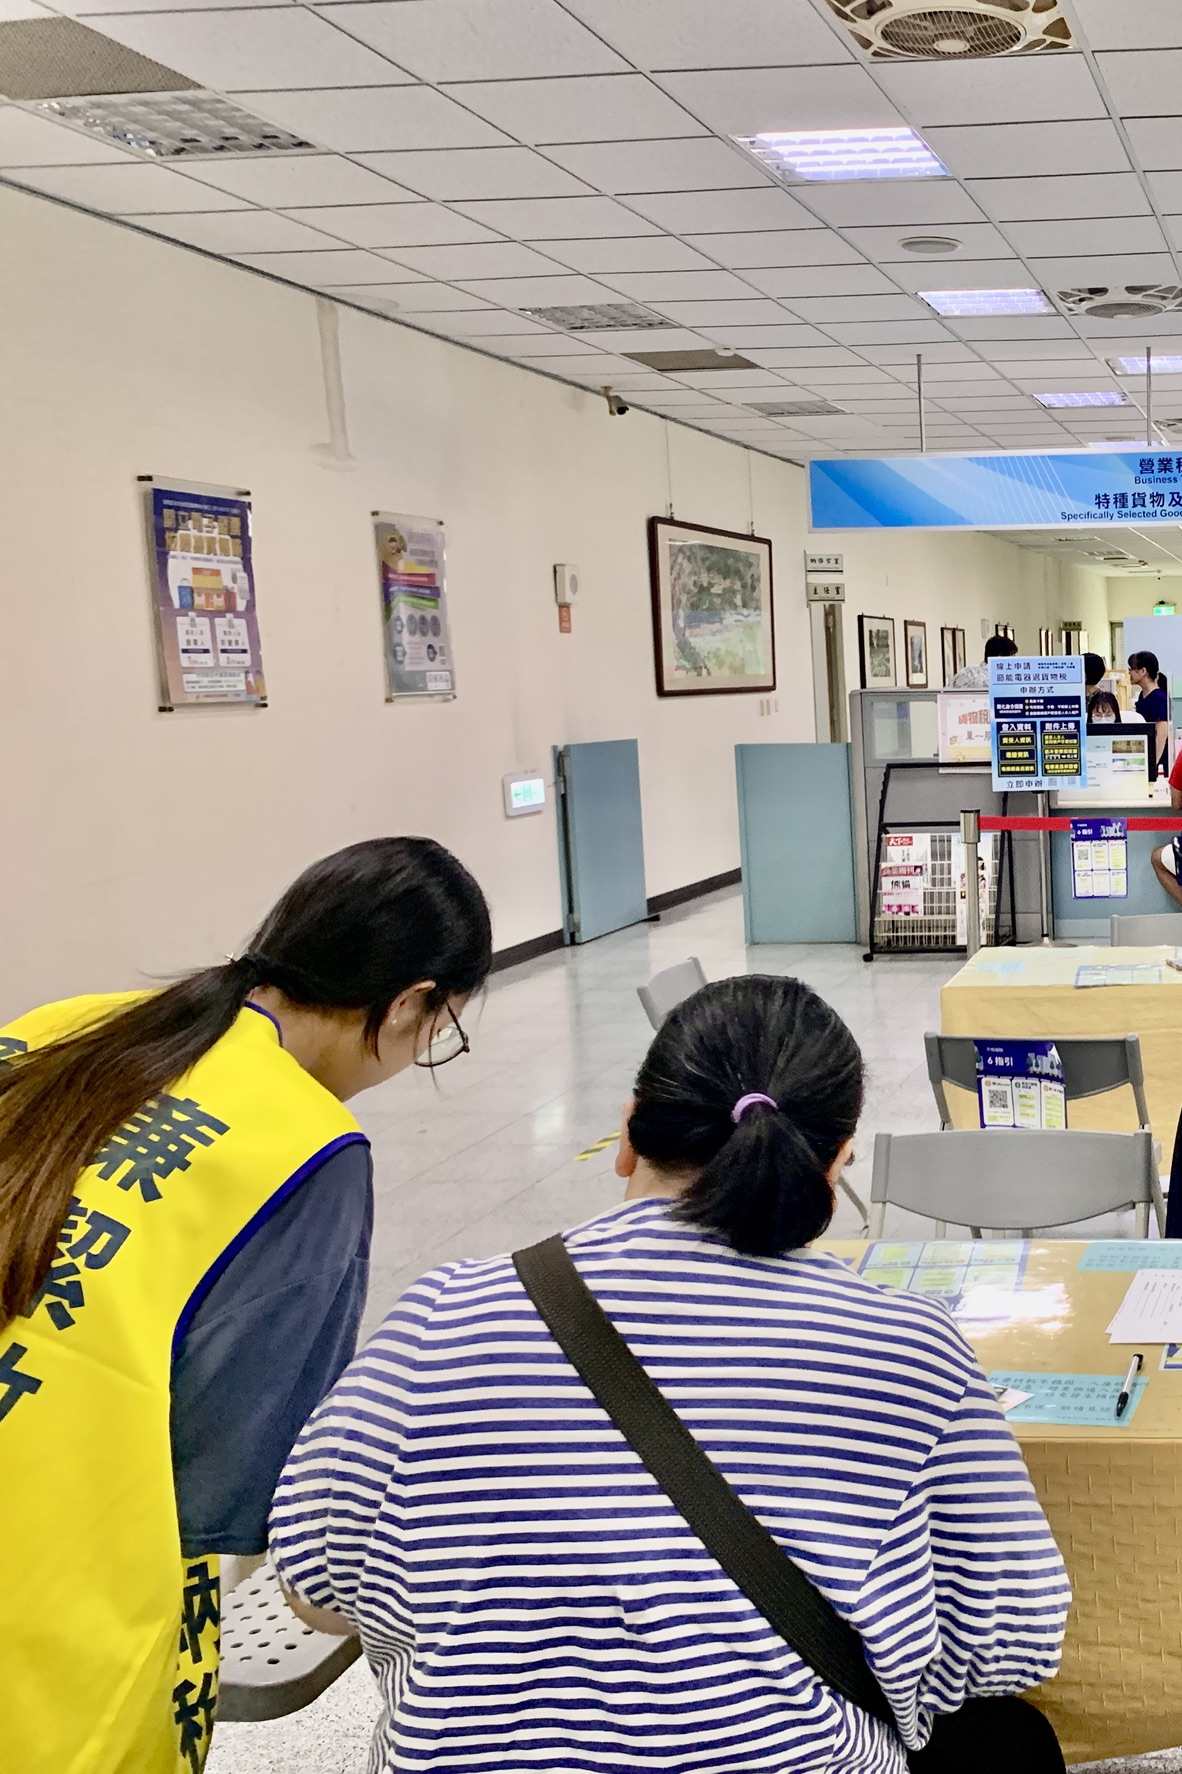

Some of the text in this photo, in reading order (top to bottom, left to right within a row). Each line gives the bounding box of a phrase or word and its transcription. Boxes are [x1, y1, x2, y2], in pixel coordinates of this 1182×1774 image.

[1134, 475, 1178, 485] Business
[1060, 509, 1114, 521] Specifically
[1117, 508, 1157, 519] Selected
[1020, 686, 1054, 694] 申辦方式
[1006, 780, 1043, 789] 立即申辦
